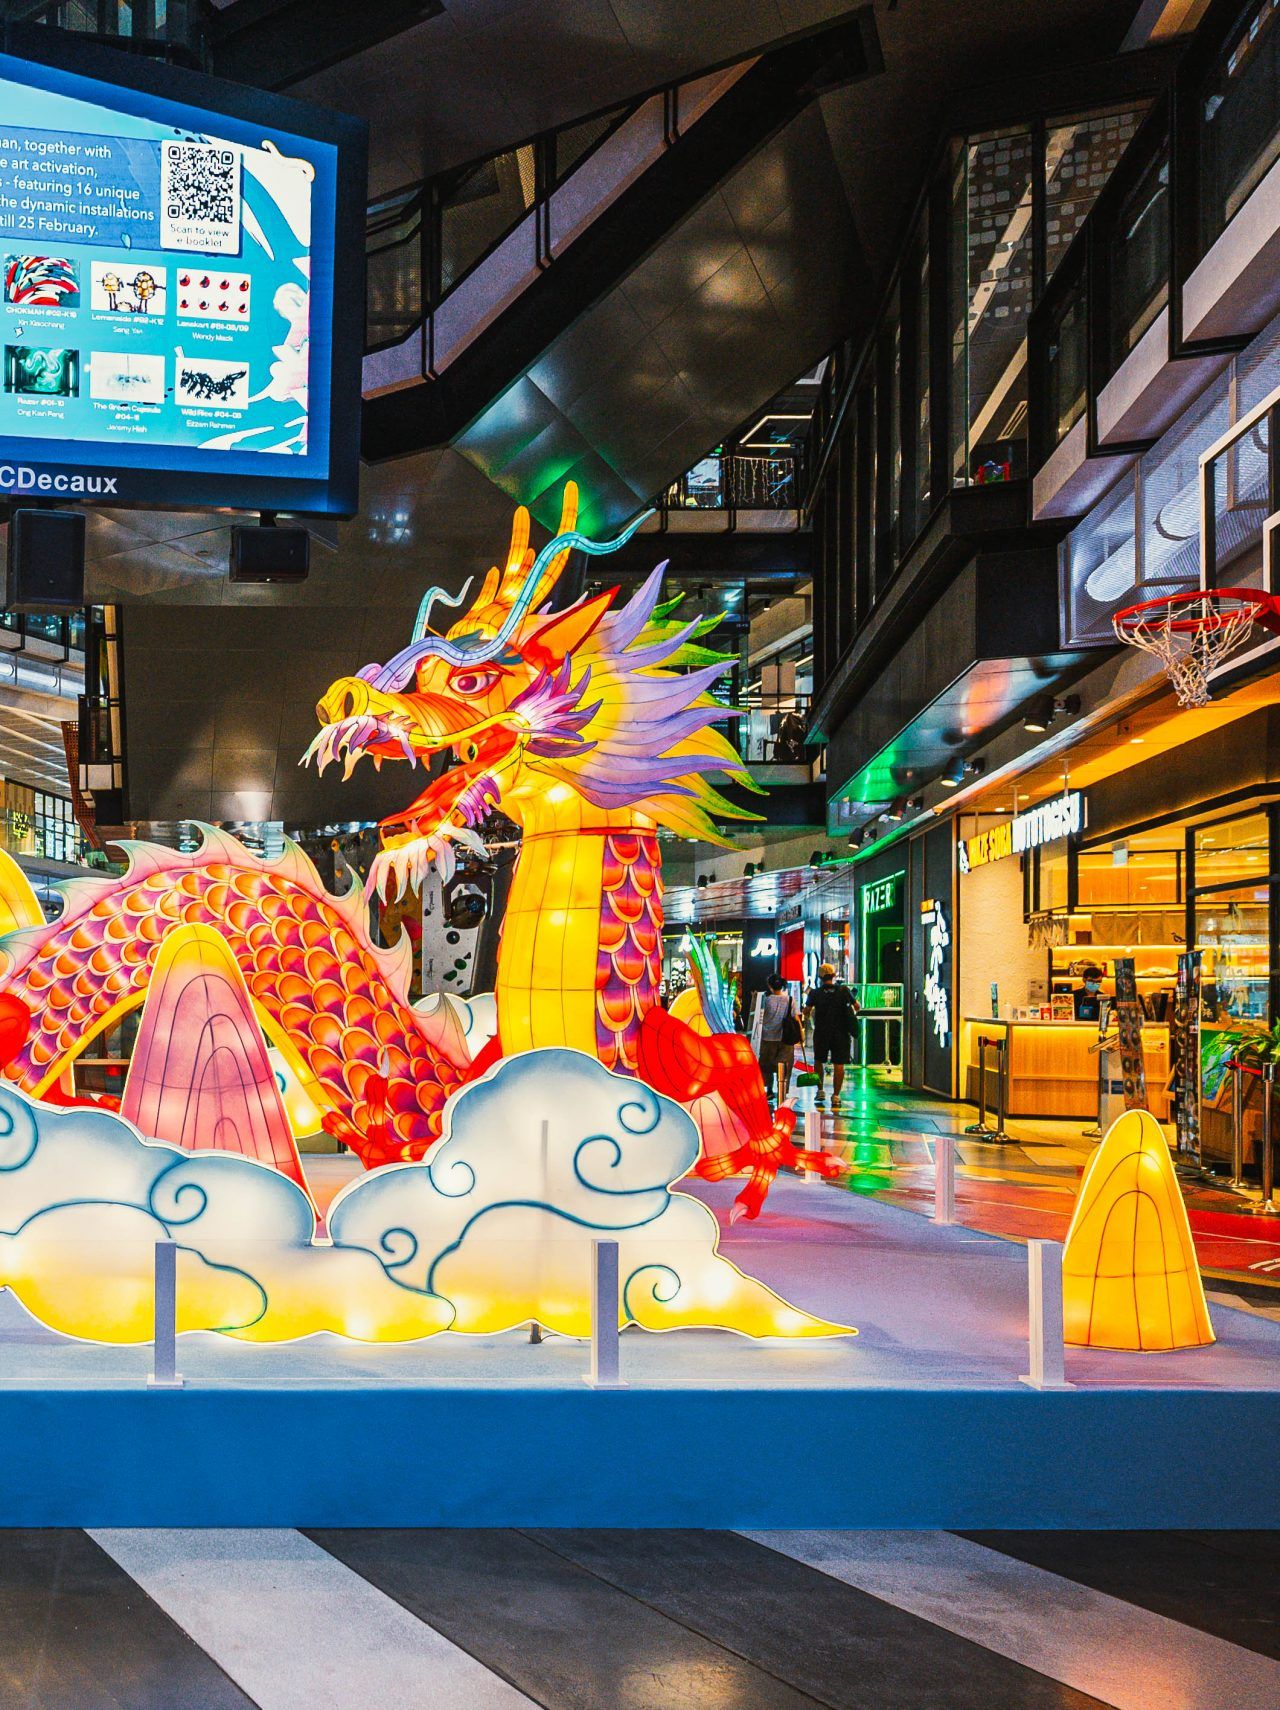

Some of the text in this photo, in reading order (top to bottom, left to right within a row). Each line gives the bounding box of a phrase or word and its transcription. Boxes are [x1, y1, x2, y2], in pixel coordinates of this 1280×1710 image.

[23, 139, 81, 155] together
[84, 144, 111, 158] with
[11, 159, 28, 170] art
[31, 160, 97, 178] activation,
[12, 174, 71, 196] featuring
[76, 181, 92, 195] 16
[95, 187, 139, 202] unique
[20, 196, 75, 213] dynamic
[79, 202, 154, 220] installations
[18, 215, 34, 229] 25
[38, 217, 98, 237] February.
[170, 224, 229, 237] Scan to view
[17, 396, 39, 404] Razer
[94, 401, 107, 410] The
[108, 402, 130, 411] Green
[180, 408, 196, 416] Wild
[865, 883, 892, 913] RAZER
